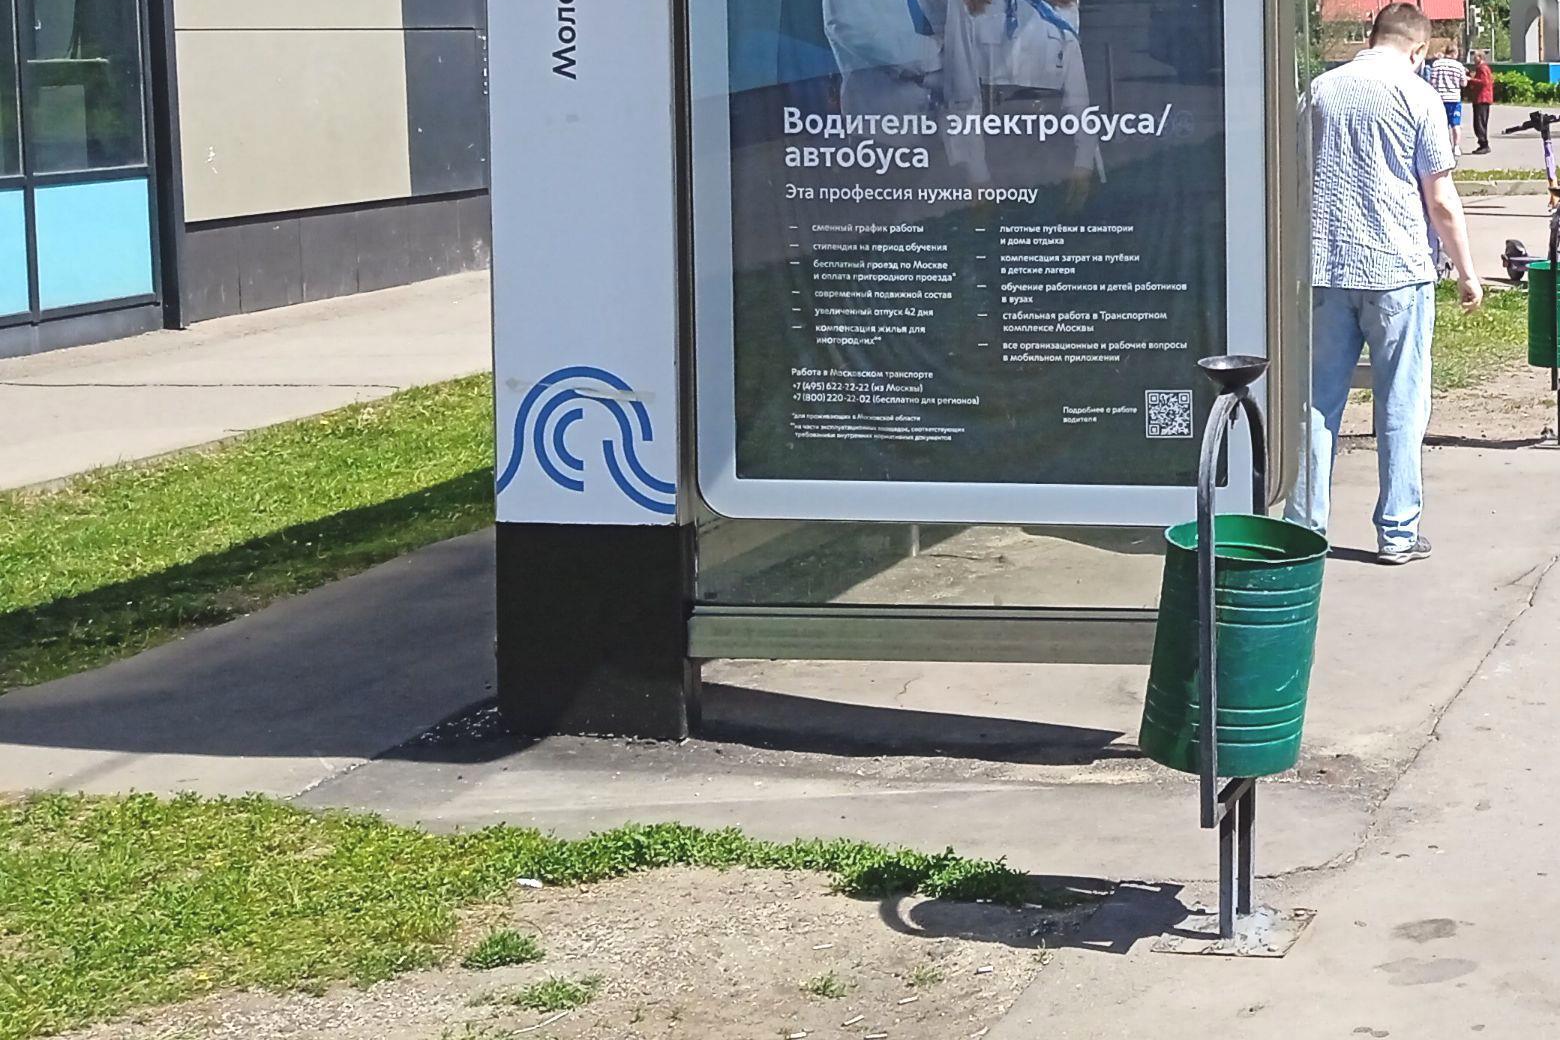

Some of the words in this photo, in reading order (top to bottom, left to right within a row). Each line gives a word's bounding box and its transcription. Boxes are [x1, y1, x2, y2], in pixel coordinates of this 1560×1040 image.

[783, 107, 937, 138] Водитель
[946, 103, 1173, 141] электробуса/
[785, 139, 930, 175] автобуса
[785, 185, 815, 200] Эта
[818, 183, 914, 203] профессия
[918, 187, 973, 202] нужна
[977, 189, 1039, 204] городу
[812, 223, 853, 233] сменный
[855, 223, 888, 235] график
[889, 224, 924, 235] работы
[1000, 225, 1041, 234] льготные
[1042, 224, 1078, 235] путёвки
[1087, 226, 1134, 234] санатории
[813, 244, 858, 253] стипендия
[872, 245, 905, 254] период
[905, 243, 948, 254] обучения
[1000, 254, 1060, 264] компенсация
[1061, 255, 1091, 264] затрат
[1105, 253, 1140, 264] путёвки
[813, 259, 865, 270] бесплатный
[867, 261, 899, 271] проезд
[900, 262, 911, 270] по
[912, 261, 949, 270] Москве
[1007, 267, 1043, 275] детские
[1044, 267, 1076, 275] лагеря
[813, 273, 820, 281] и
[821, 273, 851, 281] оплата
[853, 273, 914, 283] пригородного
[1001, 282, 1044, 292] обучение
[1045, 282, 1098, 292] работников
[1107, 281, 1133, 292] детей
[1134, 282, 1187, 292] работников
[814, 289, 873, 299] современный
[874, 290, 923, 300] подвижной
[924, 291, 953, 300] состав
[1009, 296, 1034, 305] вузах
[814, 307, 873, 317] увеличенный
[874, 308, 904, 318] отпуск
[904, 308, 916, 317] 42
[916, 309, 934, 318] дня
[1002, 311, 1056, 321] стабильная
[1058, 311, 1091, 321] работа
[1099, 311, 1168, 322] Транспортном
[815, 325, 877, 335] компенсация
[877, 325, 908, 335] жилья
[908, 326, 926, 335] для
[1003, 324, 1054, 333] комплексе
[1055, 323, 1095, 333] Москвы
[1003, 342, 1018, 350] все
[1020, 341, 1099, 351] организационные
[1100, 342, 1107, 350] и
[1108, 341, 1147, 351] рабочие
[1148, 341, 1188, 351] вопросы
[1010, 354, 1062, 362] мобильном
[1064, 354, 1121, 362] приложении
[791, 368, 822, 378] Работа
[829, 368, 884, 378] Московском
[885, 371, 934, 380] транспорте
[792, 382, 802, 391] +7
[802, 382, 825, 392] (495)
[826, 382, 870, 392] 622-22-22
[871, 383, 884, 393] (из
[885, 383, 924, 393] Москвы)
[792, 393, 802, 402] +7
[802, 393, 826, 403] (800)
[826, 393, 871, 404] 220-22-02
[872, 394, 920, 404] (бесплатно
[920, 396, 936, 405] для
[937, 395, 980, 406] регионов)
[1062, 406, 1105, 415] Подробнее
[1112, 406, 1138, 415] работе
